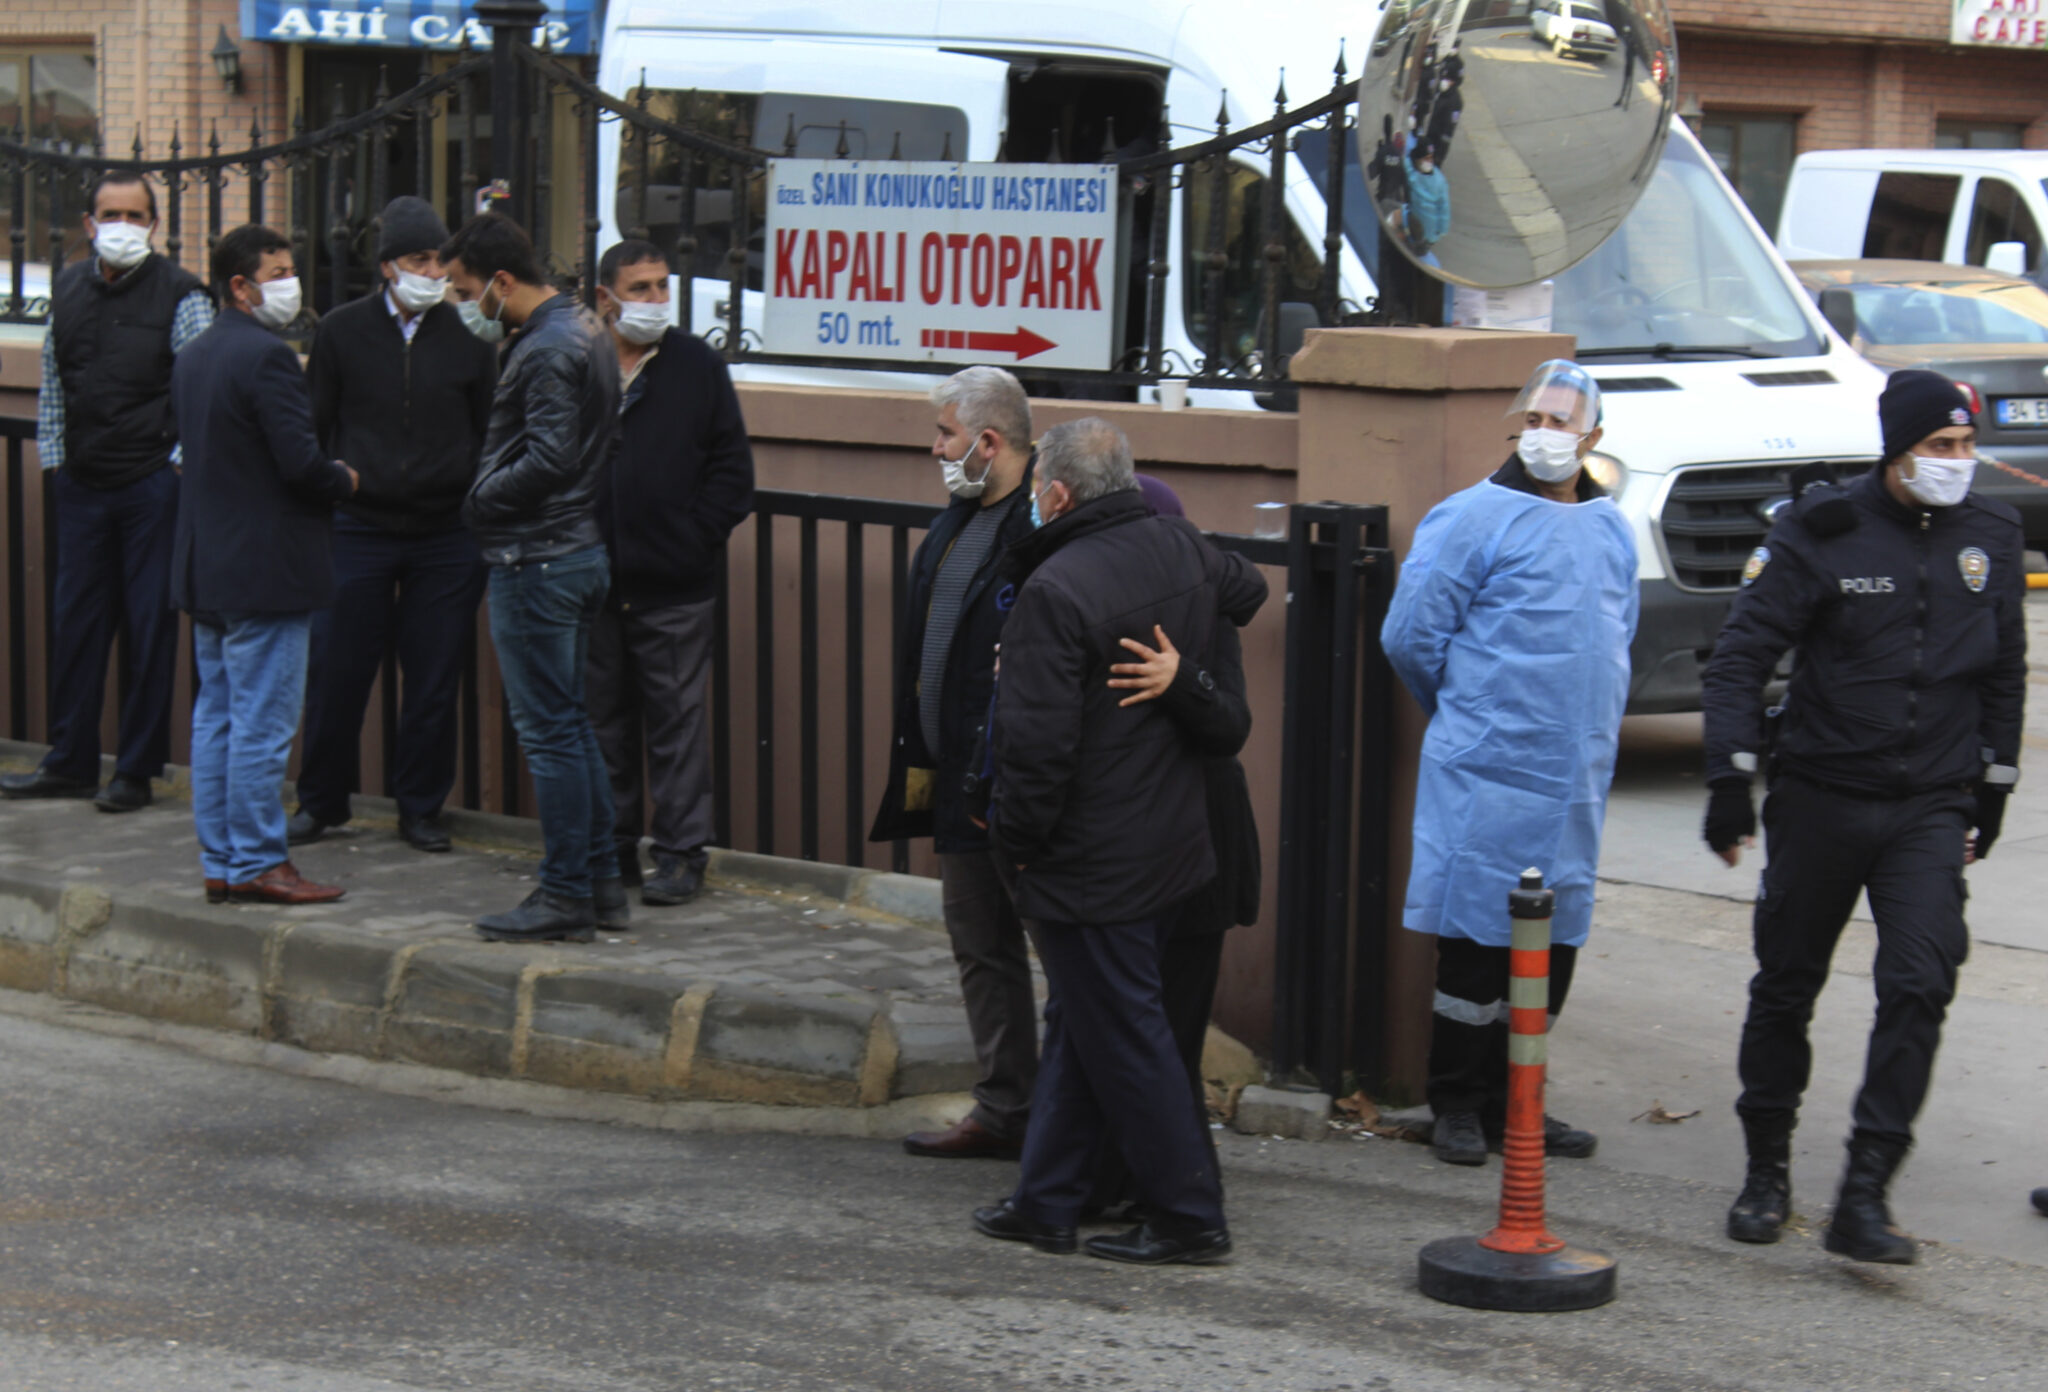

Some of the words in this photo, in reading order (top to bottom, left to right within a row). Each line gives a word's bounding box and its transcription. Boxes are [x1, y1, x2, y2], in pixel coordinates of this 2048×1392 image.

[270, 6, 387, 40] AHİ
[410, 15, 571, 48] CAE
[1974, 16, 2047, 43] CAFE
[777, 184, 806, 205] ÖZEL
[812, 162, 859, 206] SANİ
[865, 166, 985, 210] KONUKOĞLU
[992, 167, 1107, 213] HASTANESİ
[774, 228, 906, 302] KAPALI
[920, 231, 1104, 311] OTOPARK
[818, 311, 849, 344] 50
[858, 315, 900, 346] mt.
[2009, 401, 2028, 420] 34
